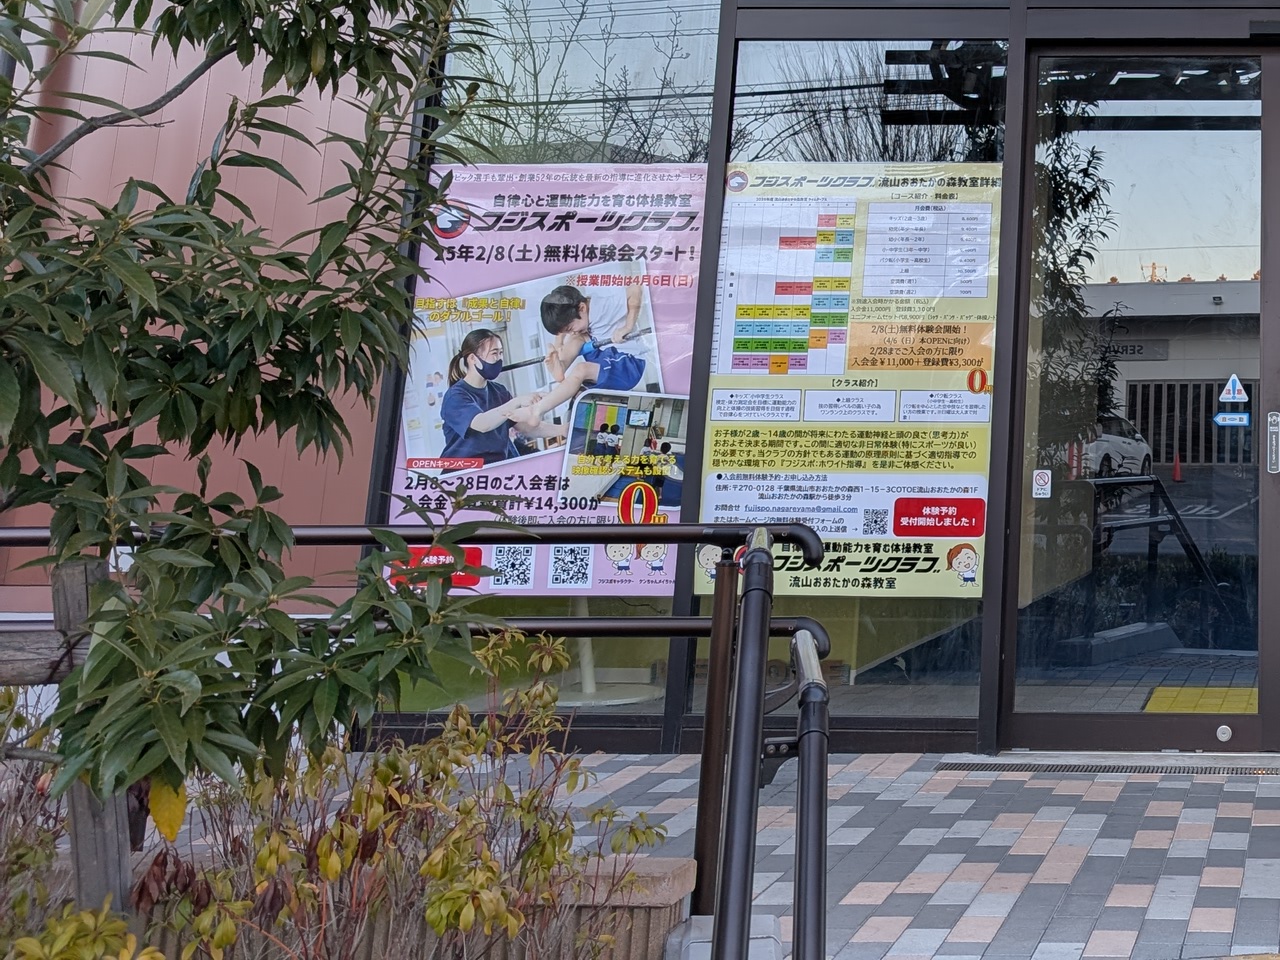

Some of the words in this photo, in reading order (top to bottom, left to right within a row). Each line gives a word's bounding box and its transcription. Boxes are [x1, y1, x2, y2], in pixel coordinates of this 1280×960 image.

[749, 176, 875, 188] フジスポーツクラブ
[493, 194, 692, 208] 自律心と運動能力を育む体操教室
[473, 211, 700, 232] フジスポーツクラブ
[412, 460, 478, 468] OPENキャンペーン
[922, 506, 957, 516] 体験予約
[789, 576, 897, 589] 流山おおたかの森教室
